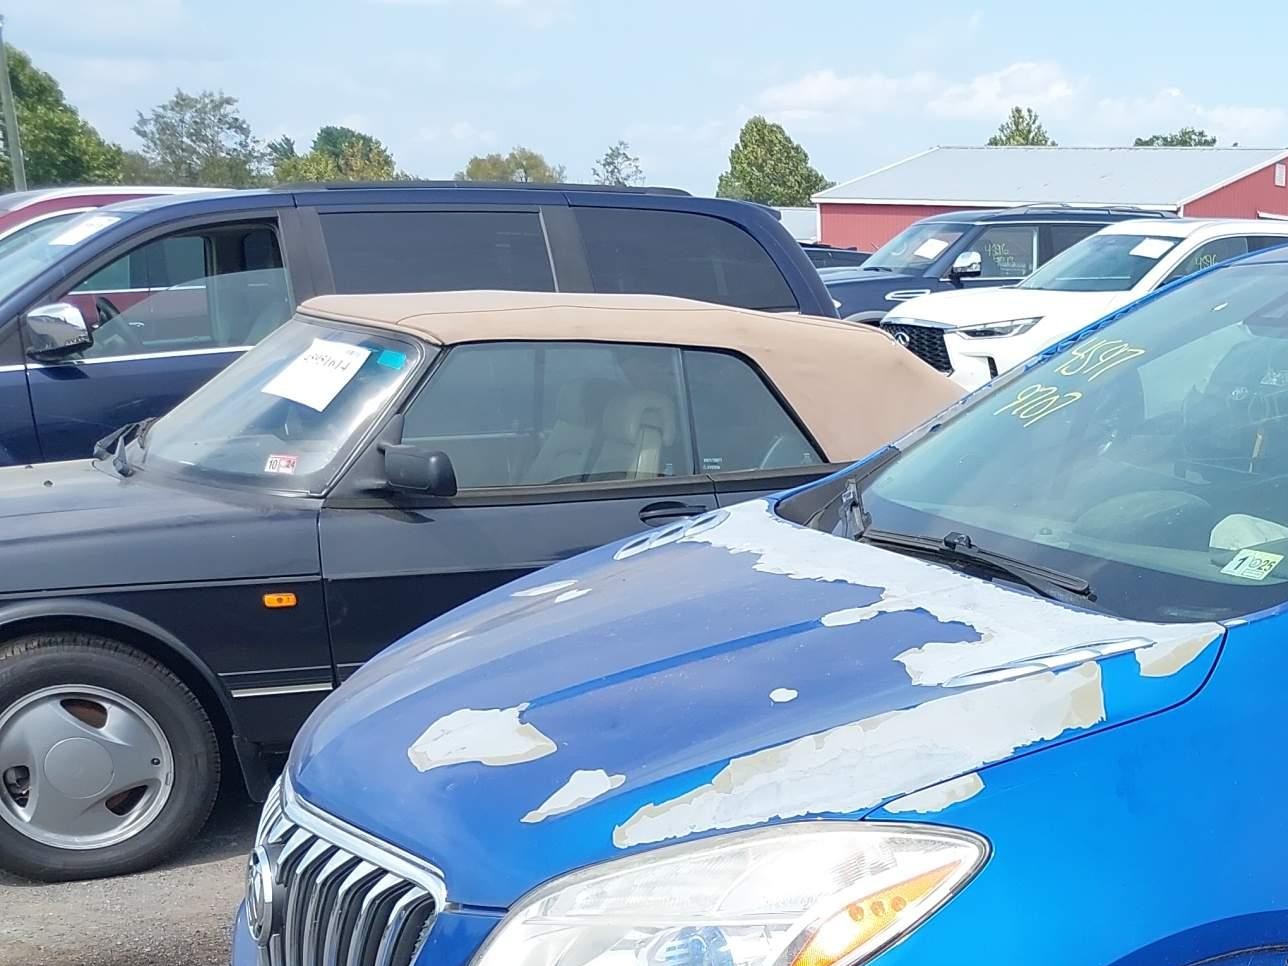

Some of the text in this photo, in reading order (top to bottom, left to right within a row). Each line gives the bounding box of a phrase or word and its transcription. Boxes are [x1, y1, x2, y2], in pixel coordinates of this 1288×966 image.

[1053, 338, 1146, 382] 4597
[993, 384, 1083, 428] 9707
[1257, 559, 1277, 572] 25
